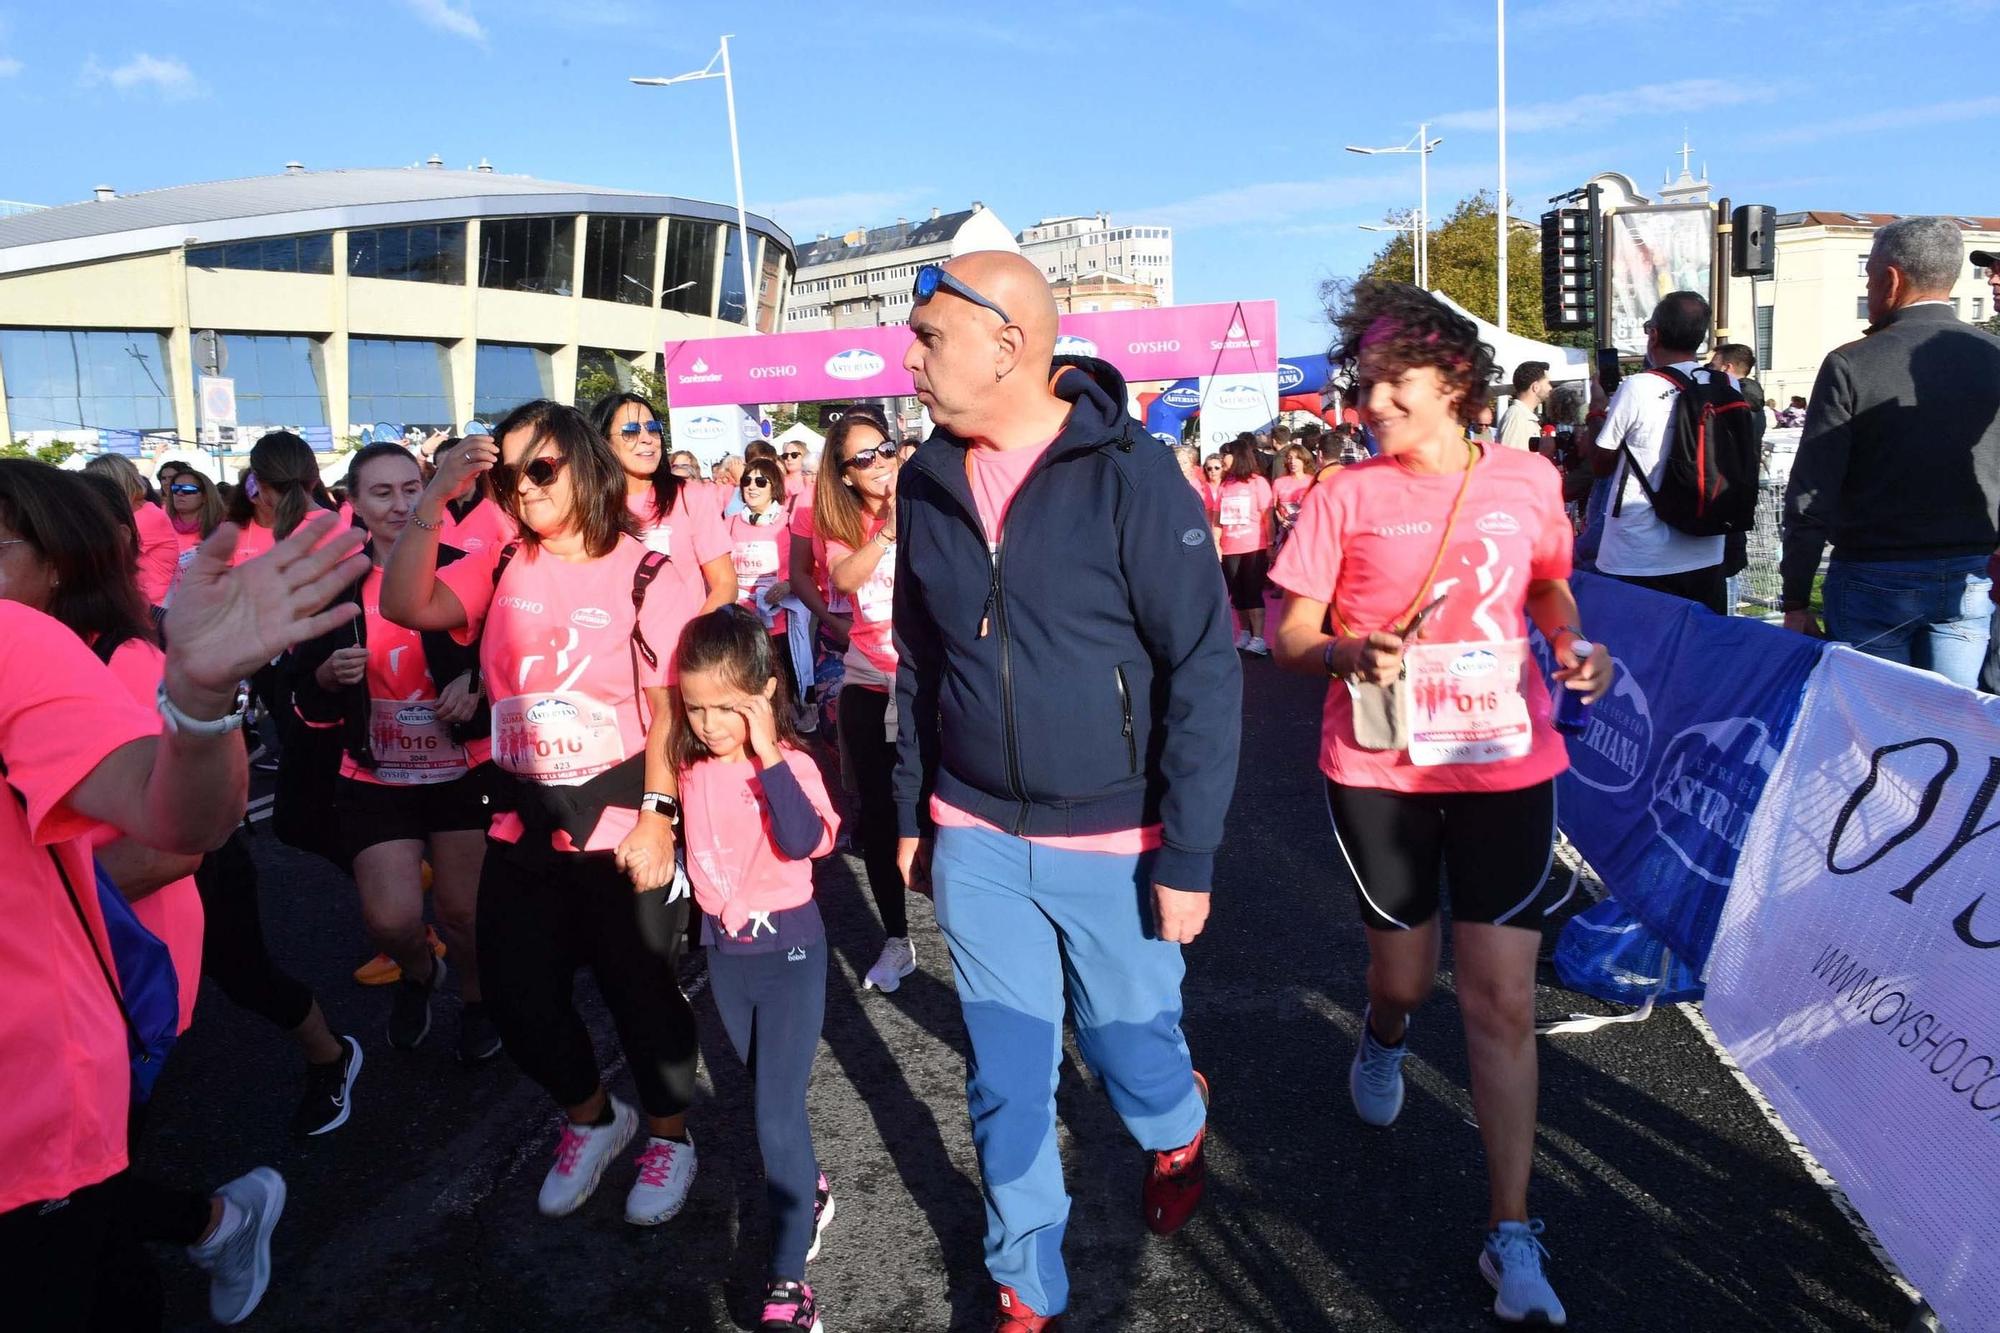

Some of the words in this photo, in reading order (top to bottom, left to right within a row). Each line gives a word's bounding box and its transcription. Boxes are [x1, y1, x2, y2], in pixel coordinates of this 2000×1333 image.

[1128, 340, 1181, 354] OYSHO
[1210, 338, 1262, 350] Santander
[749, 364, 797, 378] OYSHO
[679, 373, 724, 384] Santander
[498, 597, 544, 614] OYSHO
[1457, 691, 1498, 712] 016
[400, 735, 437, 749] 016
[1811, 944, 2000, 1122] WWW.OYSHO.CO
